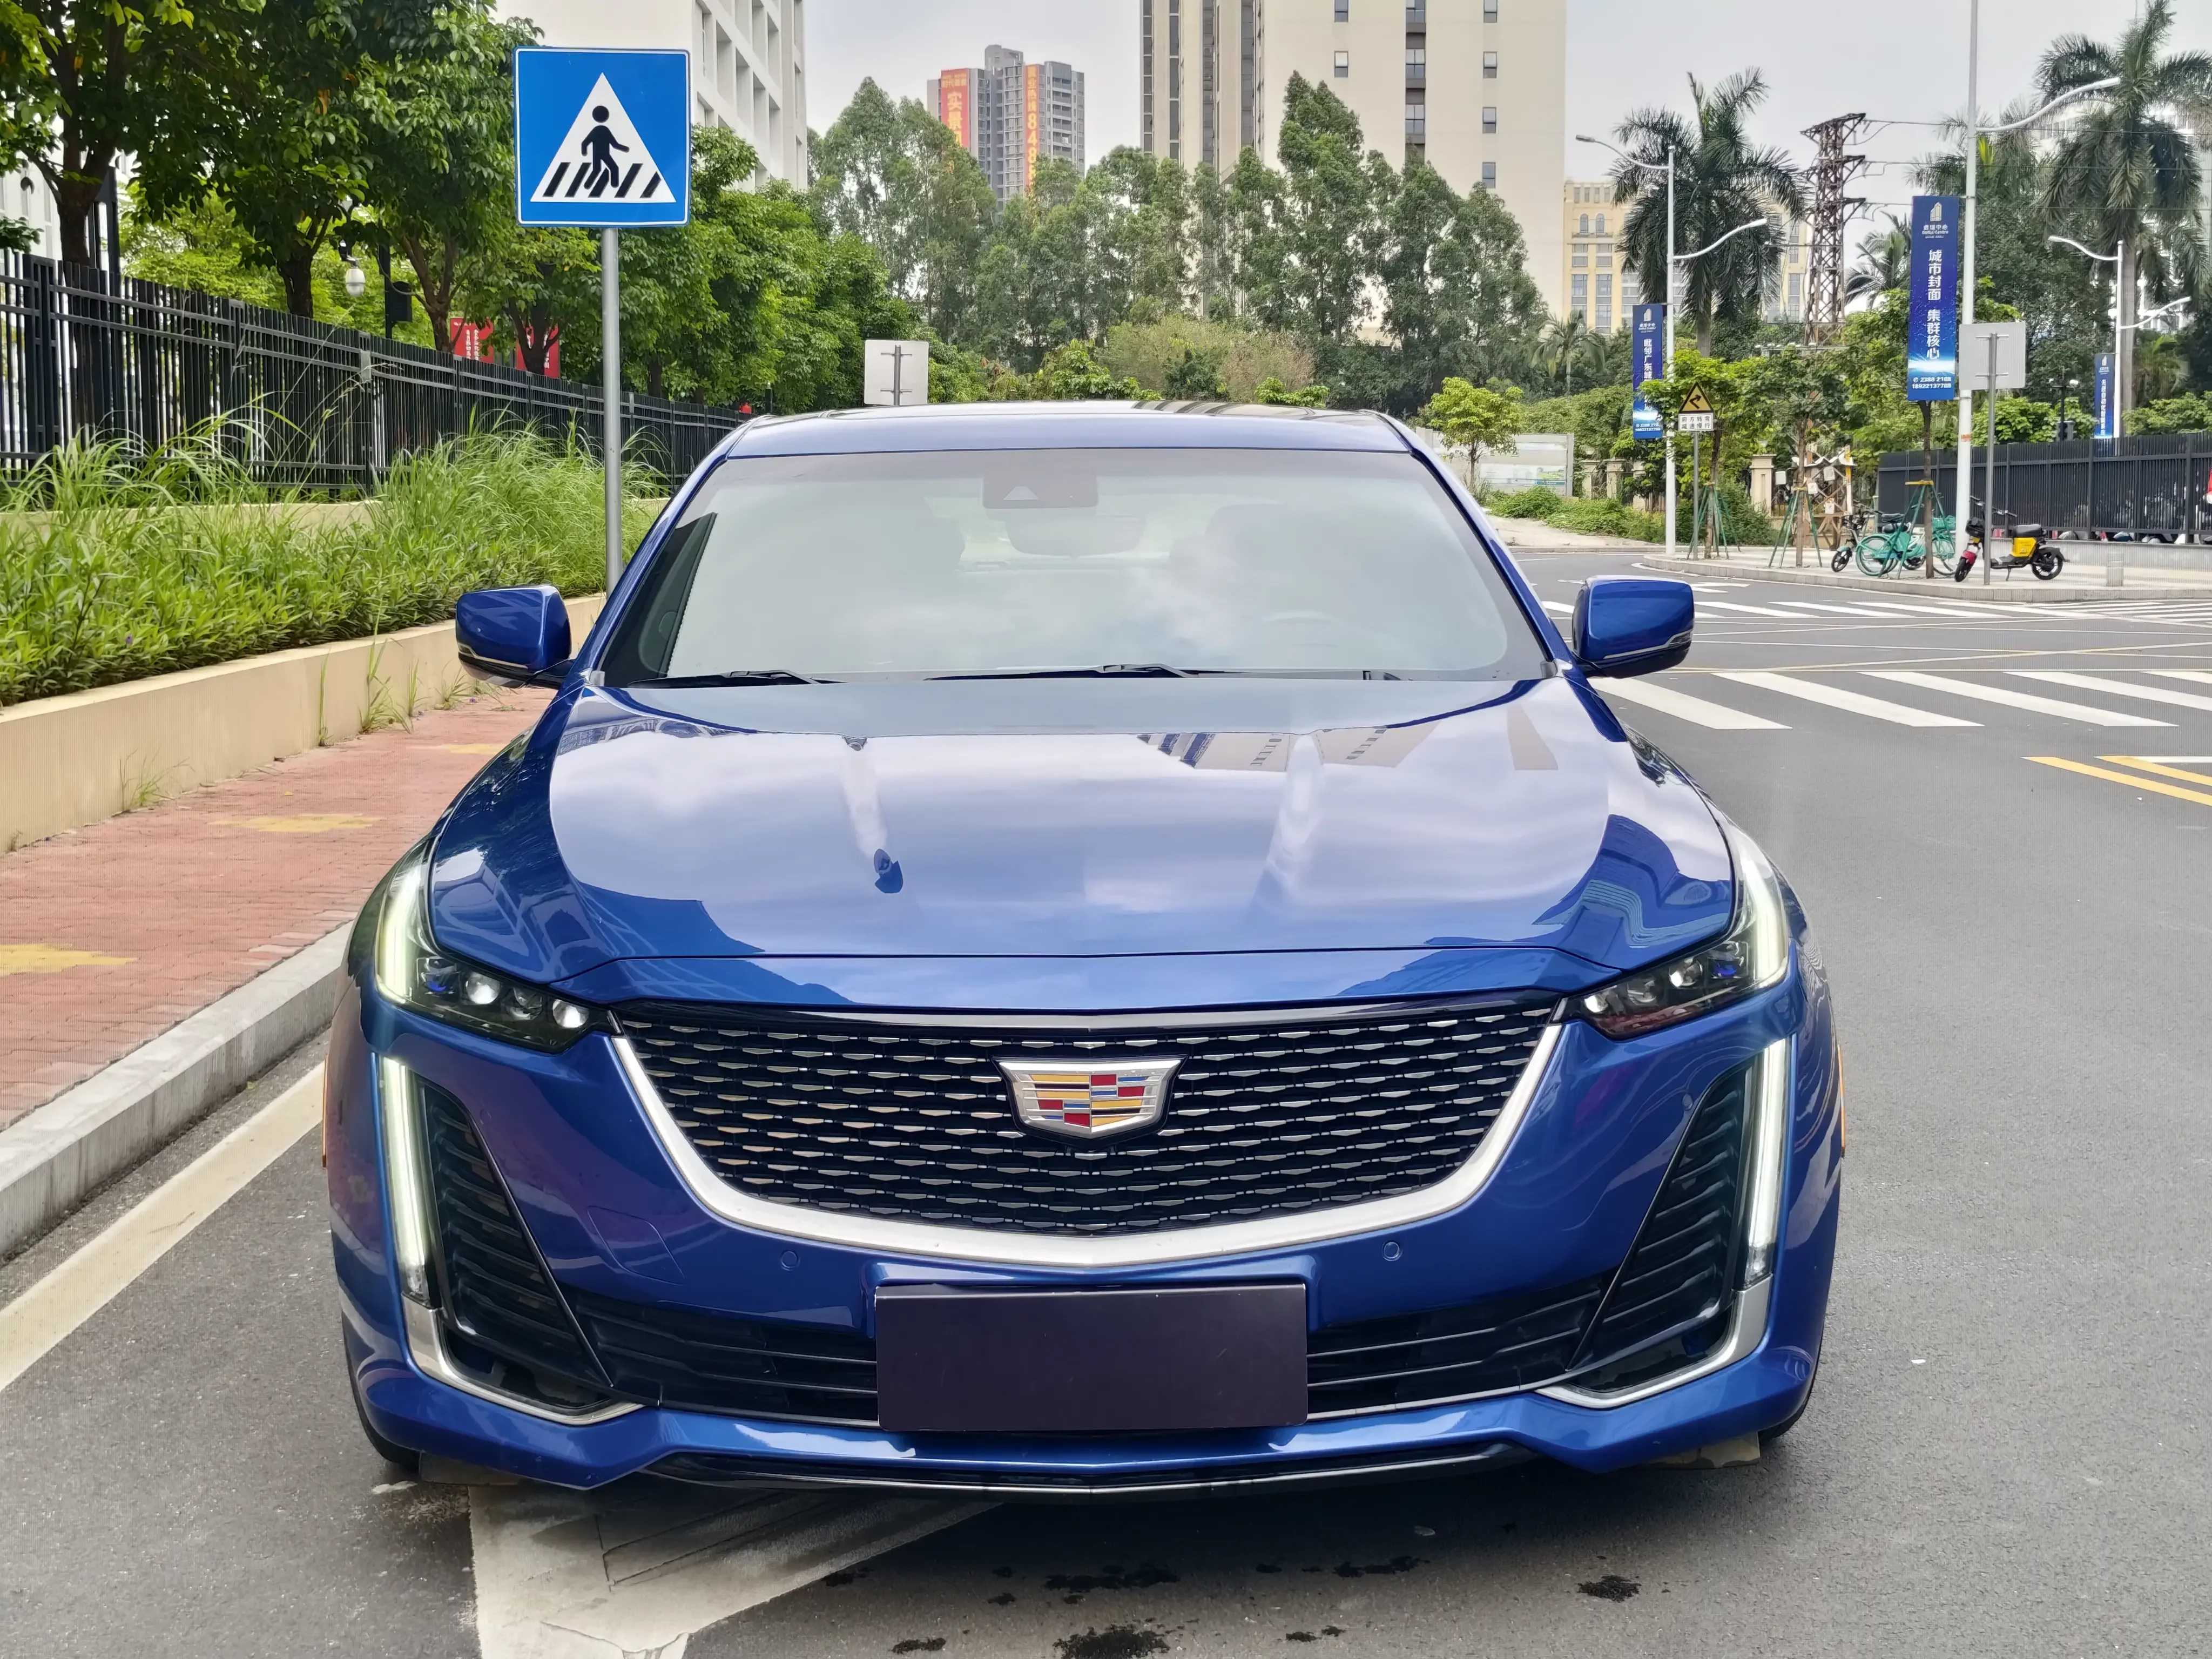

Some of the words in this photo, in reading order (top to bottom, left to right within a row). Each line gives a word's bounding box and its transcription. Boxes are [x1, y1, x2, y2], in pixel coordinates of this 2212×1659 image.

[1927, 249, 1943, 301] 城市封面
[1926, 309, 1940, 359] 集群核心
